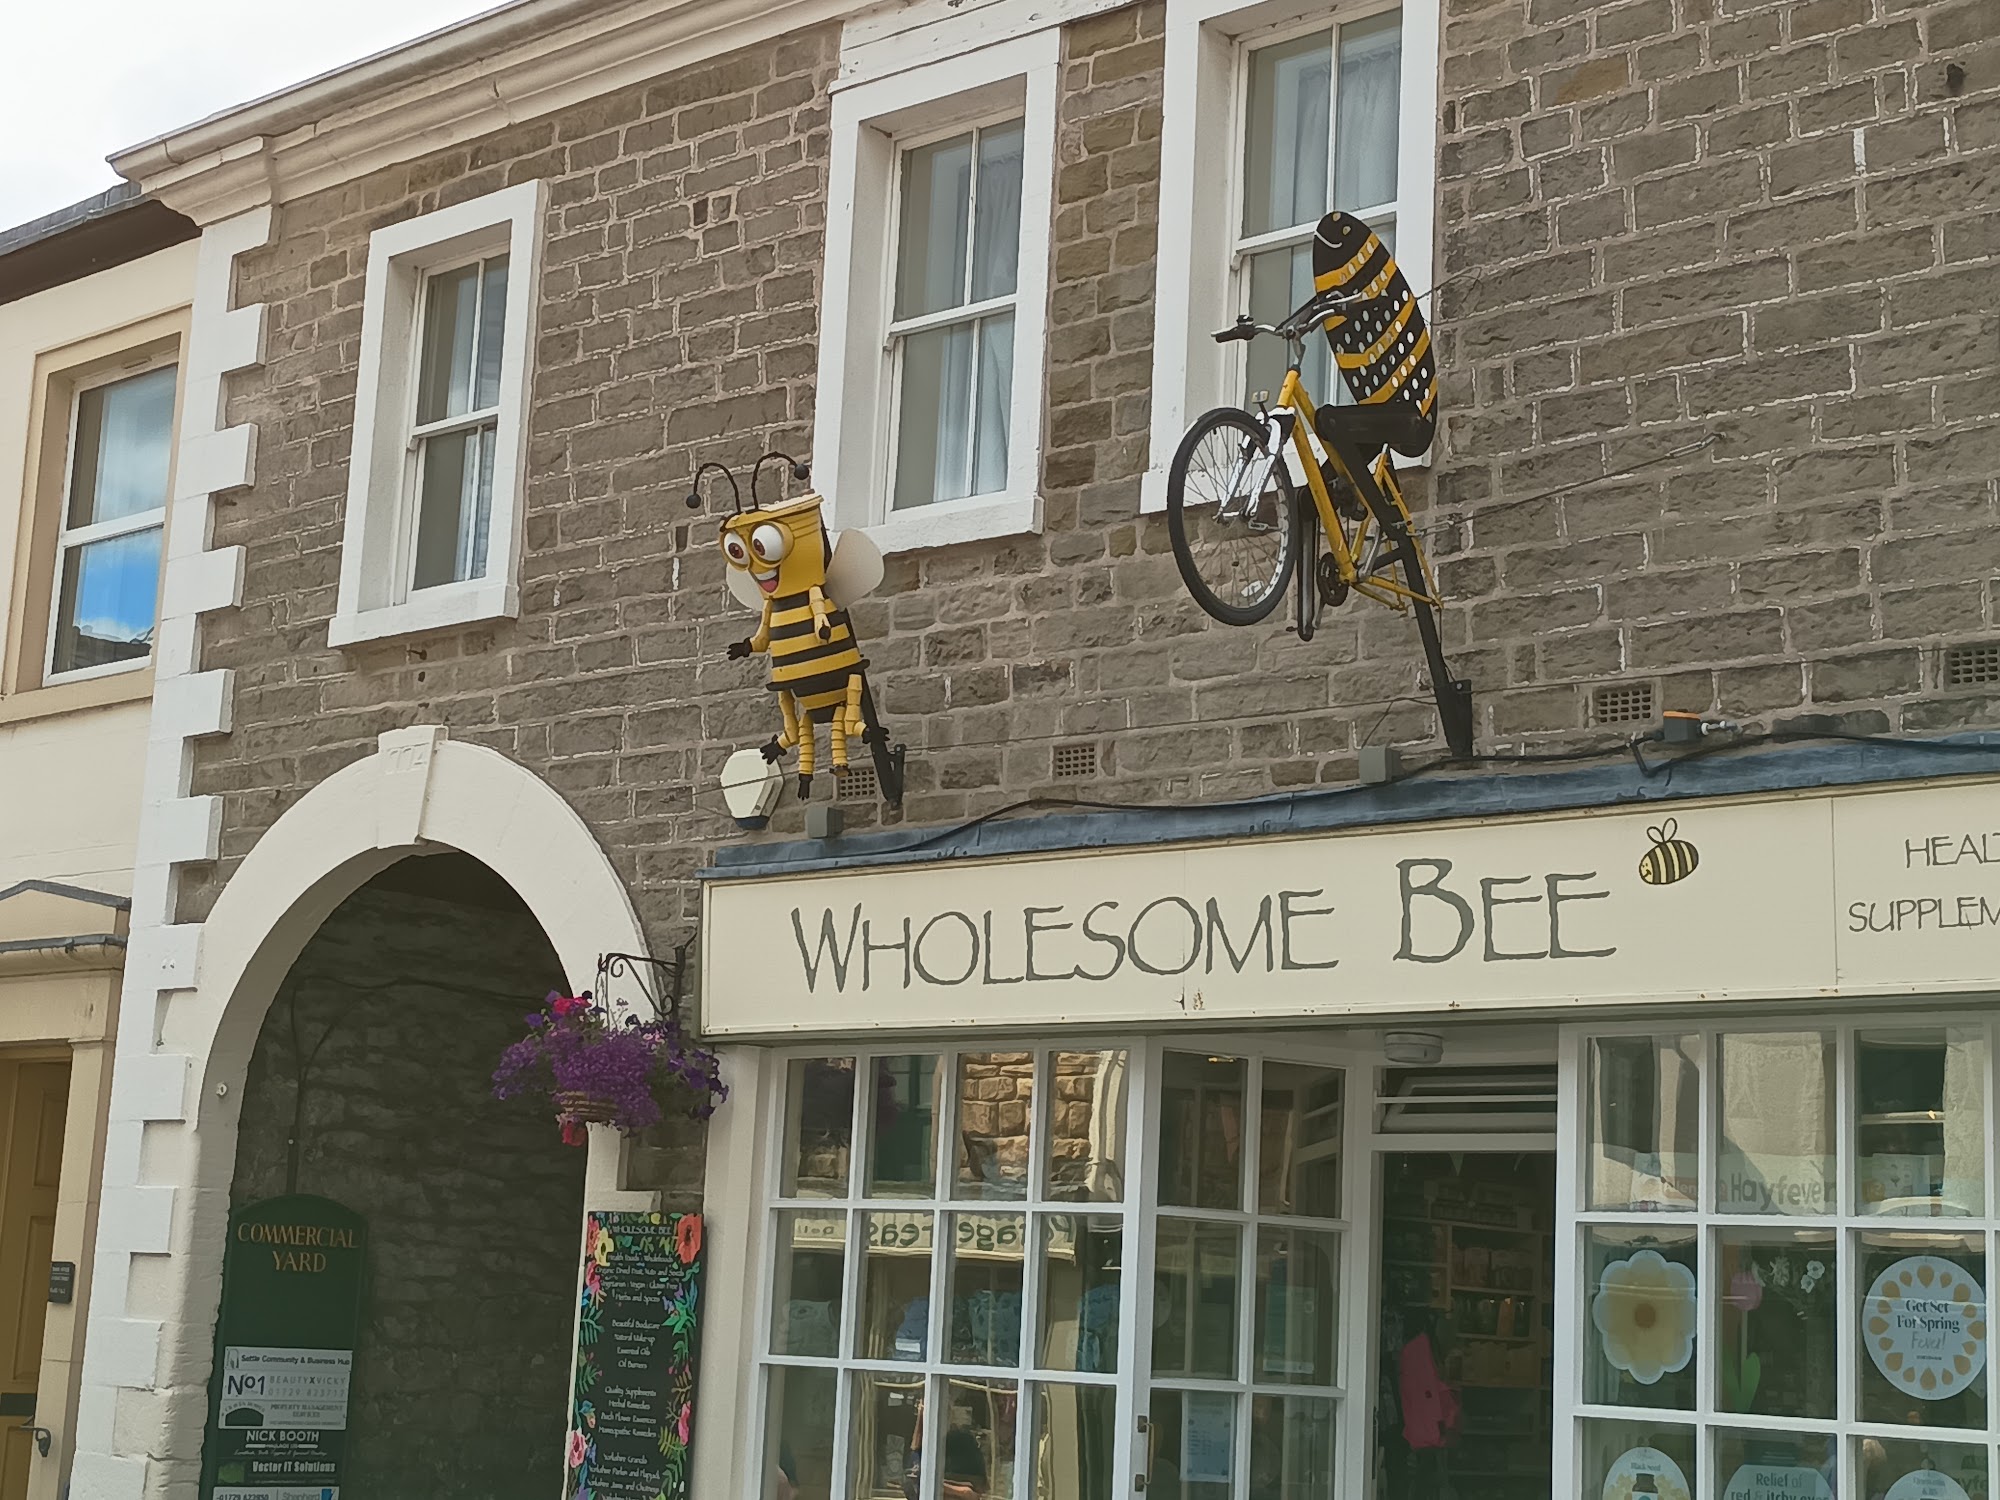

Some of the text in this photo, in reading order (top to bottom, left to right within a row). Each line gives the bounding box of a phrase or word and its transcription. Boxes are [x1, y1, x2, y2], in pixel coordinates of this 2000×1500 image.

[1905, 832, 2000, 868] HEAL
[791, 858, 1617, 993] WHOLESOME BEE
[1731, 1172, 1835, 1211] Hayfever
[237, 1222, 359, 1248] COMMERCIAL
[272, 1250, 327, 1273] YARD
[658, 1266, 668, 1276] and
[632, 1292, 642, 1301] and
[1906, 1300, 1950, 1313] Get Set
[1897, 1315, 1960, 1333] For Spring
[262, 1355, 298, 1365] Community
[307, 1357, 335, 1365] Business
[246, 1430, 320, 1442] NICK BOOTH
[252, 1461, 336, 1473] Vector IT Solutions
[629, 1467, 639, 1477] and
[626, 1480, 635, 1490] and
[1756, 1472, 1788, 1487] Relief
[1731, 1488, 1751, 1500] red
